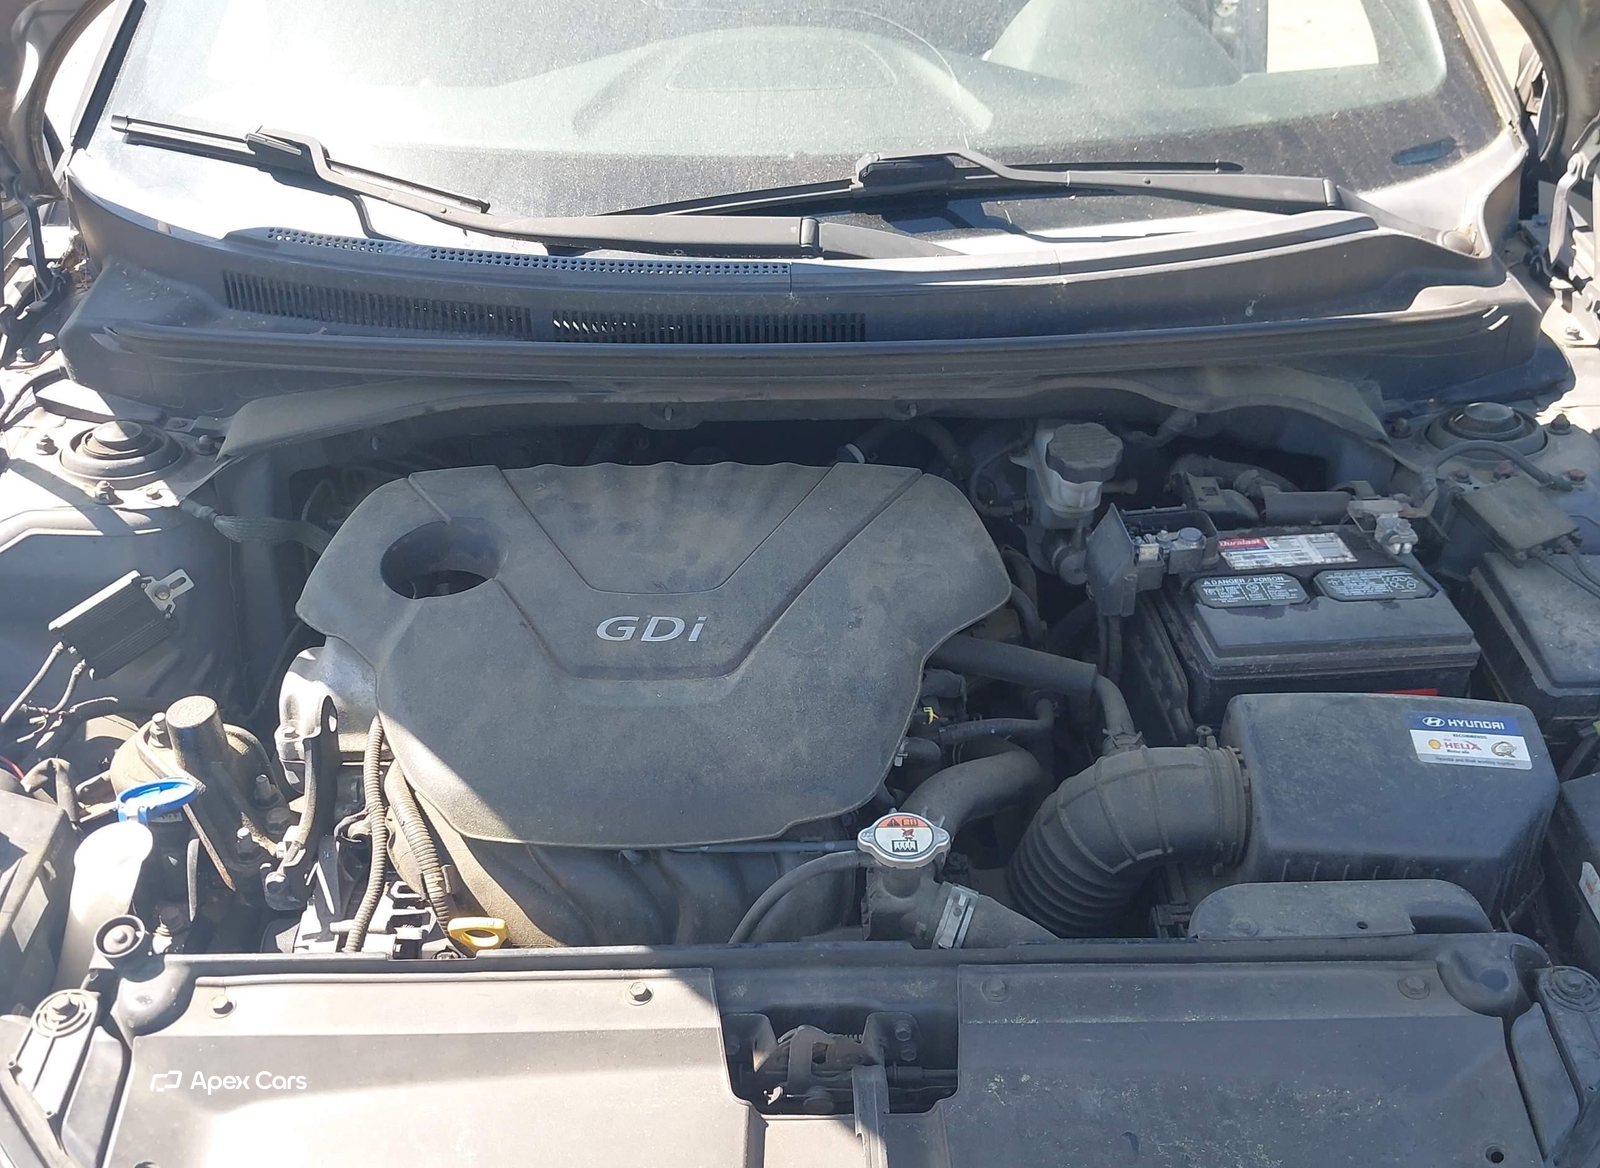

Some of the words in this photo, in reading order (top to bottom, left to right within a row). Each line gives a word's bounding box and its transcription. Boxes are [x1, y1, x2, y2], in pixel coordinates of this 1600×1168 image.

[1219, 539, 1261, 547] Duralast
[596, 615, 707, 642] GDi
[1448, 719, 1505, 730] HYUNDAI
[1444, 741, 1482, 750] HELIX
